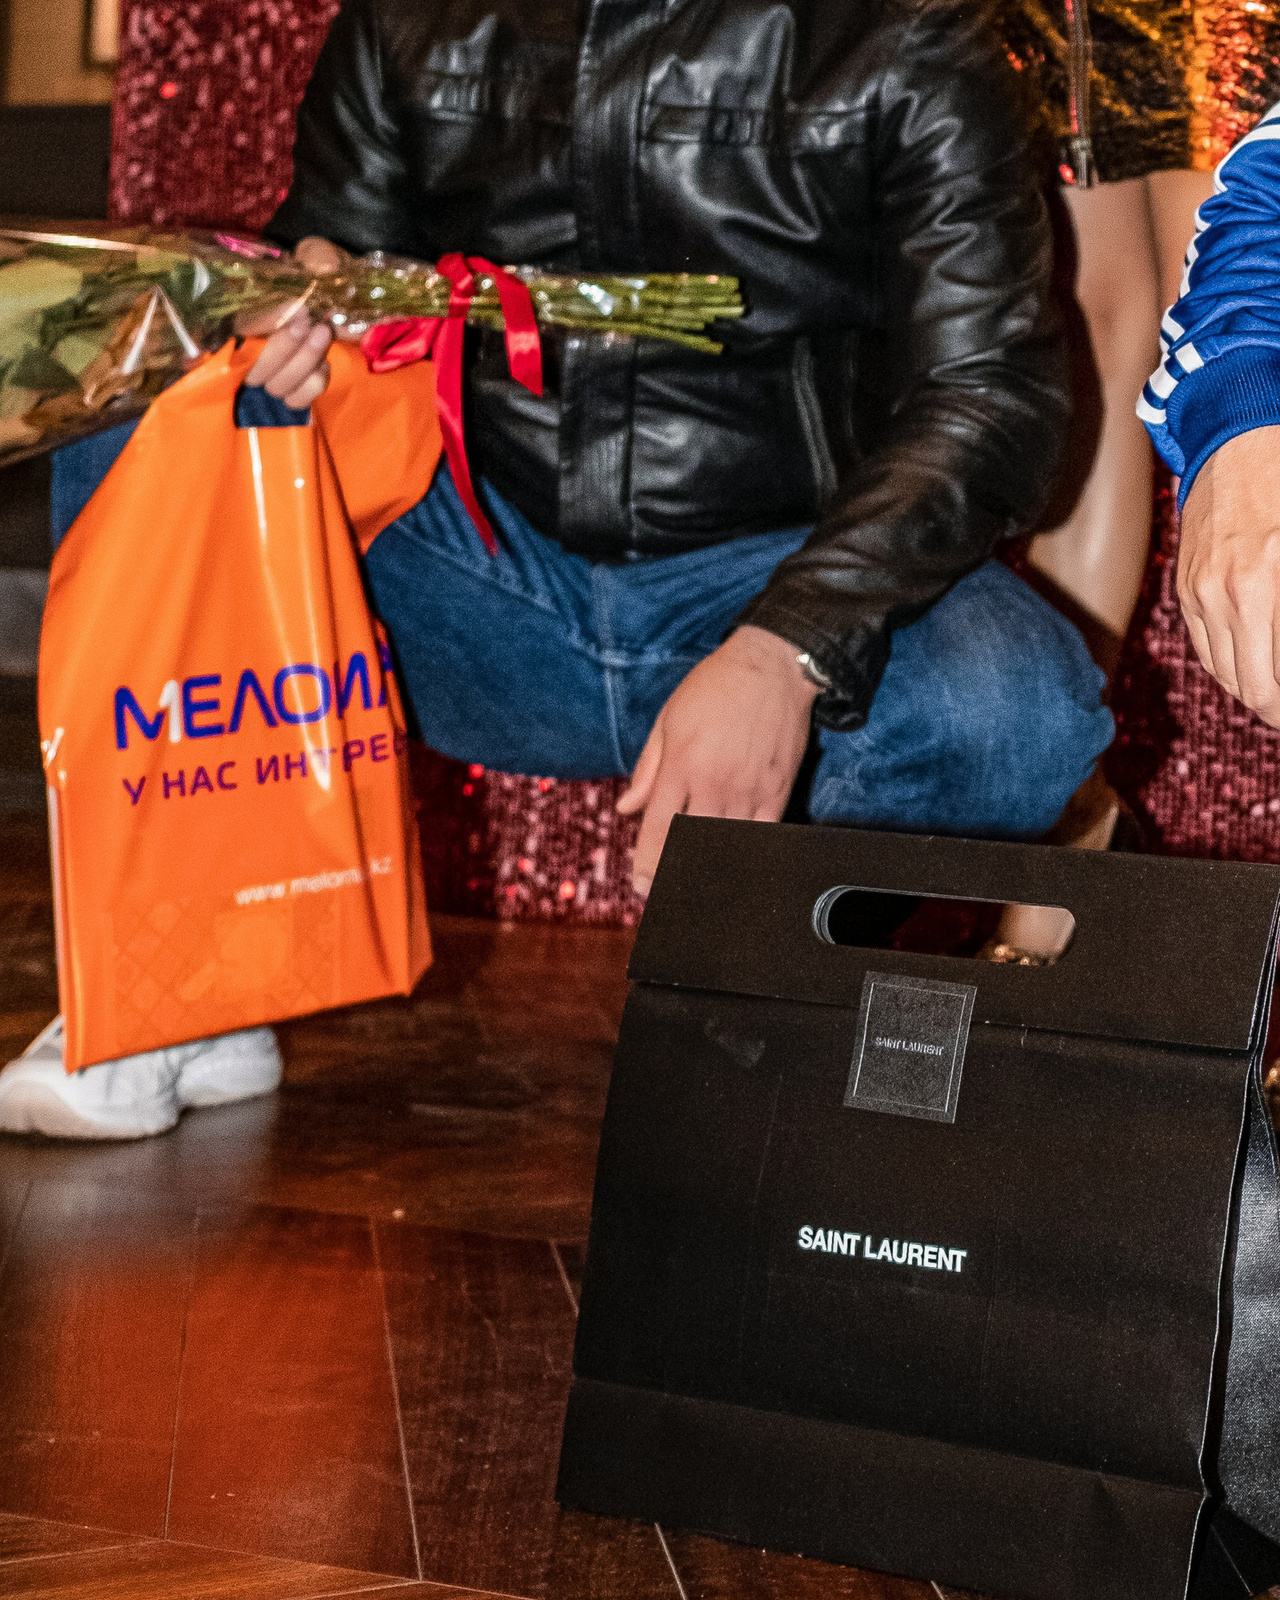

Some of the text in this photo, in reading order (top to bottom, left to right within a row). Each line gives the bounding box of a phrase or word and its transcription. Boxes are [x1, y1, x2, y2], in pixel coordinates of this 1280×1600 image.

[122, 775, 147, 805] У
[162, 760, 238, 799] НАС
[875, 1036, 945, 1056] SAINT LAURENT
[798, 1225, 967, 1273] SAINT LAURENT
